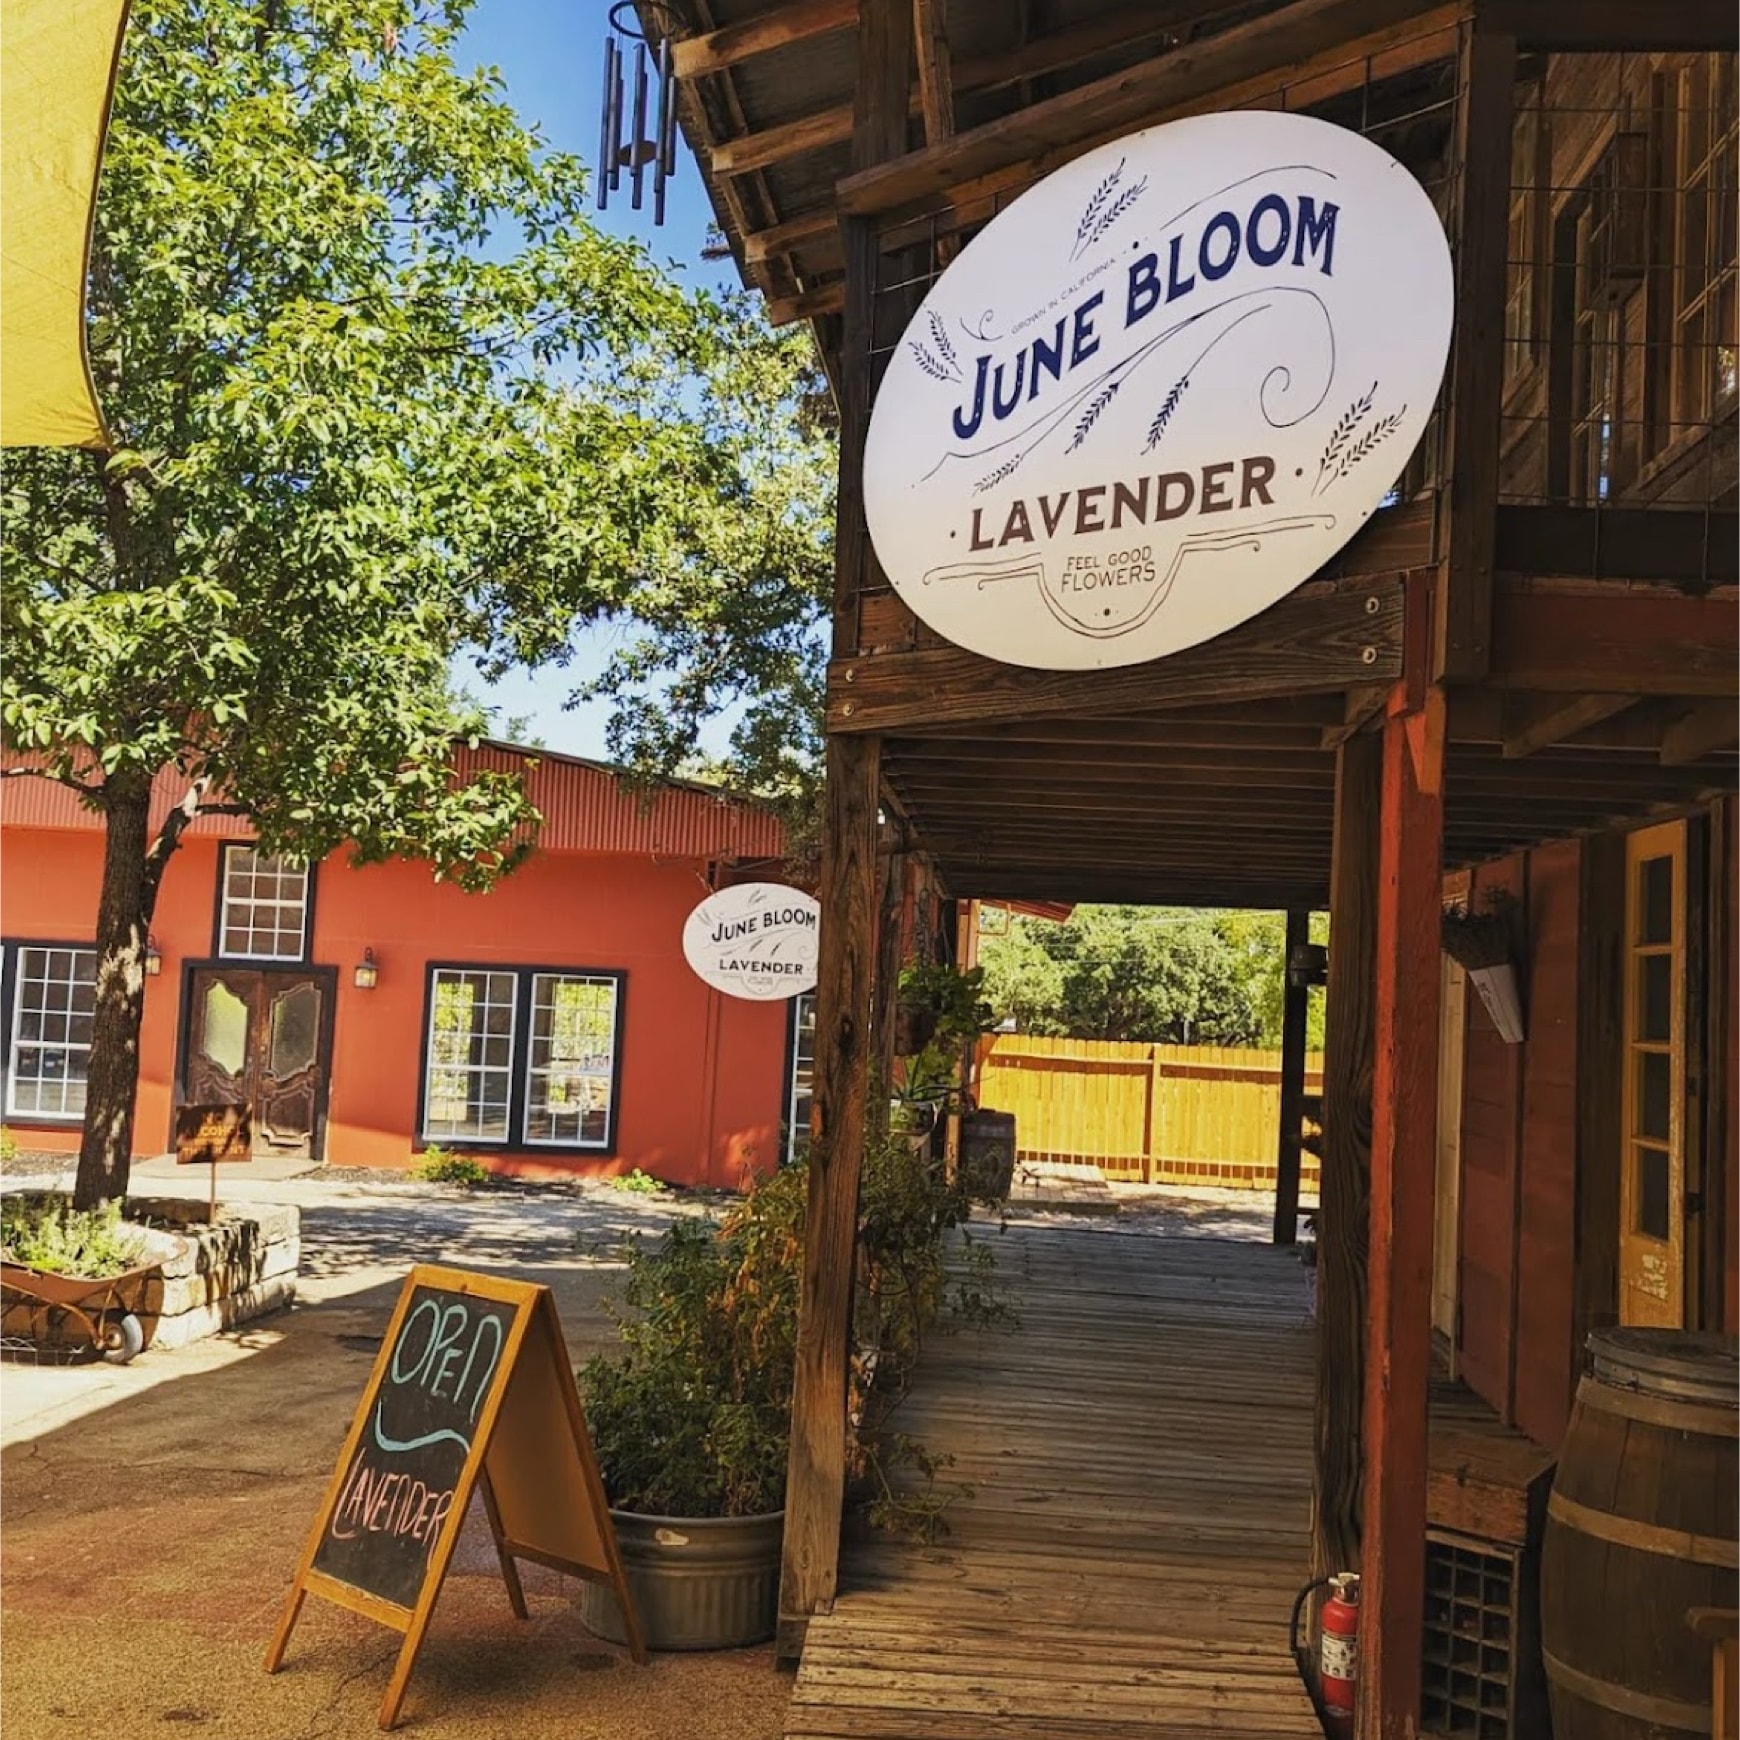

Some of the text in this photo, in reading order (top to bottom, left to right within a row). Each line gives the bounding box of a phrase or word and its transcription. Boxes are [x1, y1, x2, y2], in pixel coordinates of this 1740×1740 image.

[1060, 257, 1117, 301] CALIFORNIA
[952, 193, 1341, 439] JUNE BLOOM
[968, 455, 1276, 551] LAVENDER
[1061, 561, 1156, 593] FLOWERS
[1066, 544, 1153, 572] FEEL GOOD
[711, 917, 758, 943] JUNE
[763, 909, 816, 931] BLOOM
[719, 959, 804, 975] LAVENDER
[391, 1299, 502, 1424] OPEN
